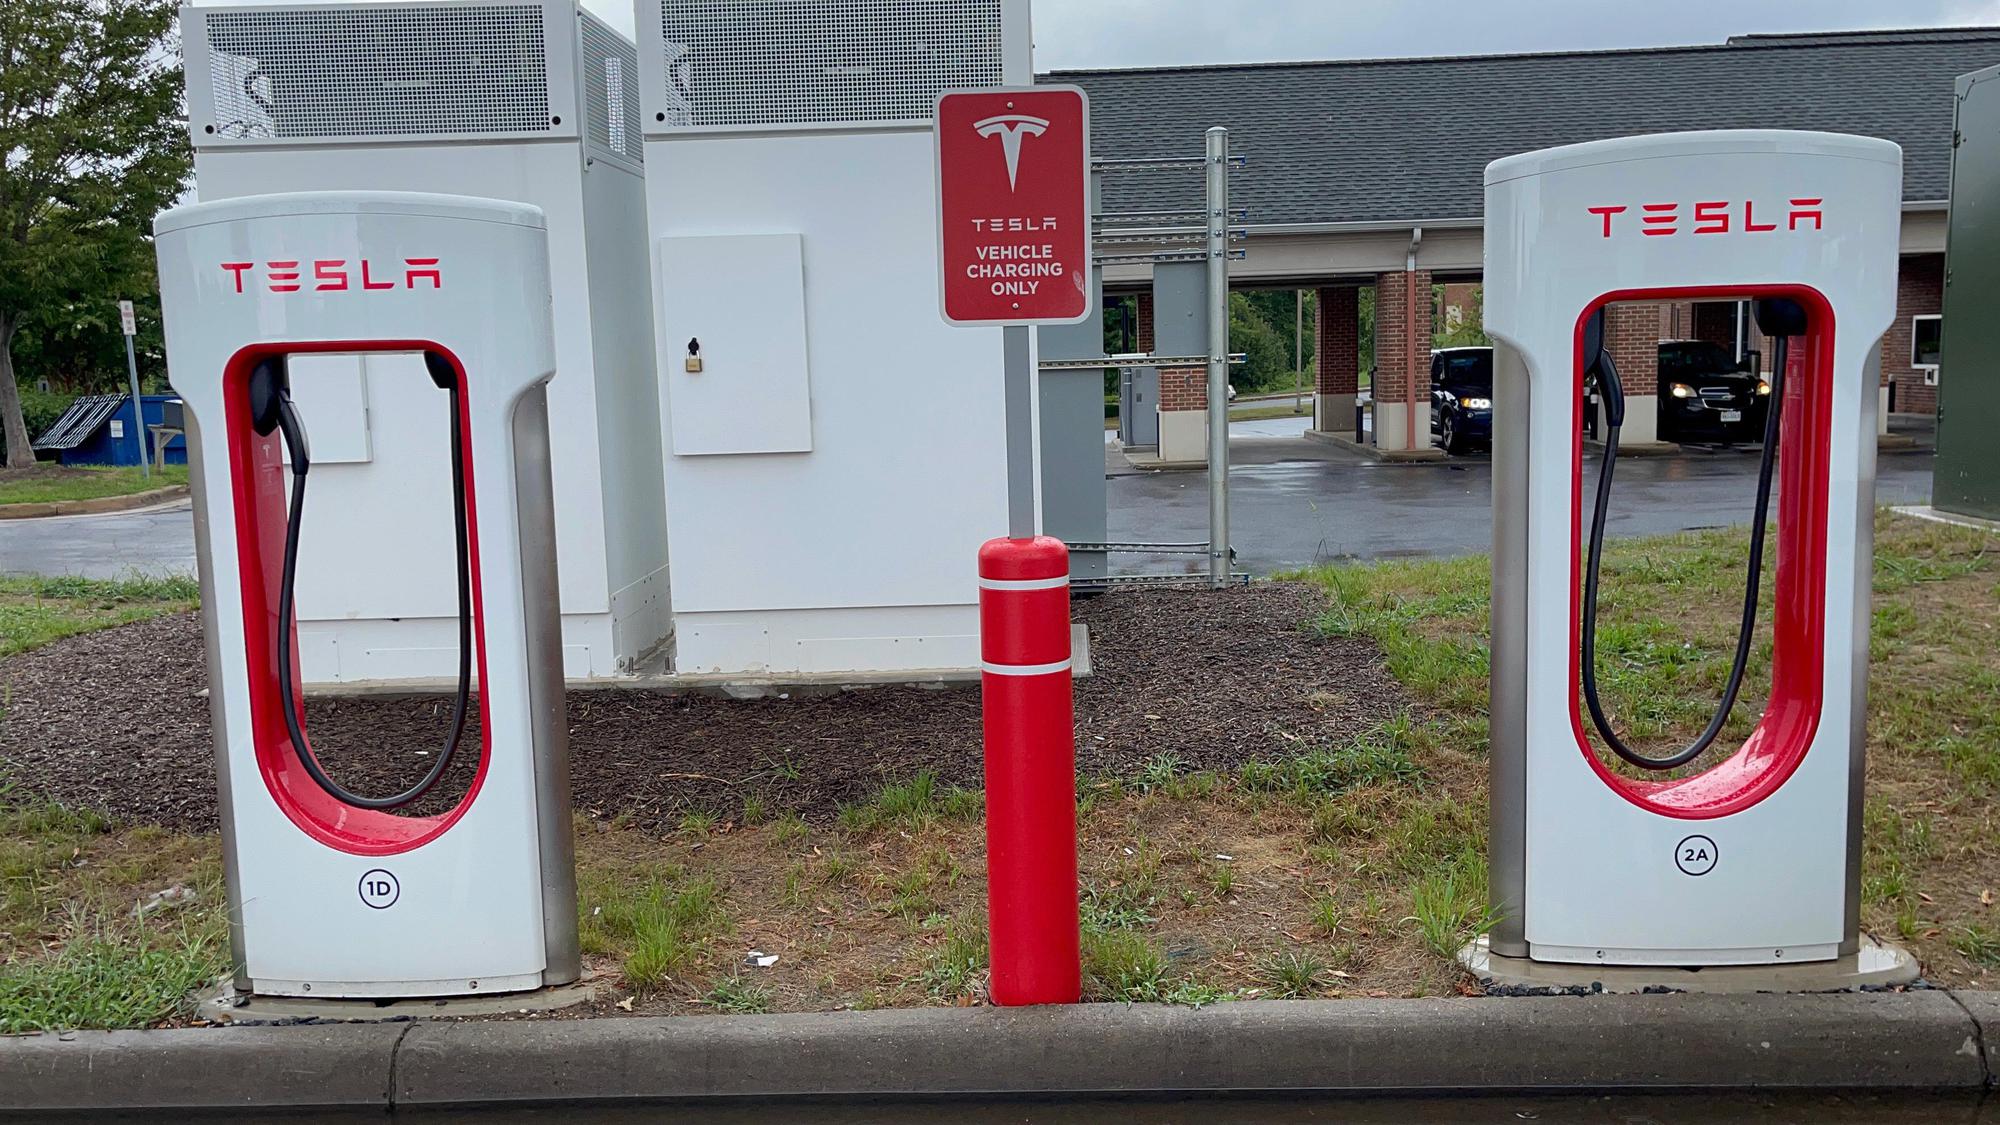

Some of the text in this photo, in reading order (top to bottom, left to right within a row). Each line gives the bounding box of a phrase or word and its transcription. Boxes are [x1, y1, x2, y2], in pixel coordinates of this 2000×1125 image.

[971, 217, 1057, 232] TESLA
[1587, 198, 1823, 238] TESLA
[976, 244, 1053, 260] VEHICLE
[220, 258, 441, 294] TESLA
[966, 262, 1063, 279] CHARGING
[991, 280, 1040, 296] ONLY
[1684, 848, 1709, 862] 2A
[366, 881, 391, 896] 1D
